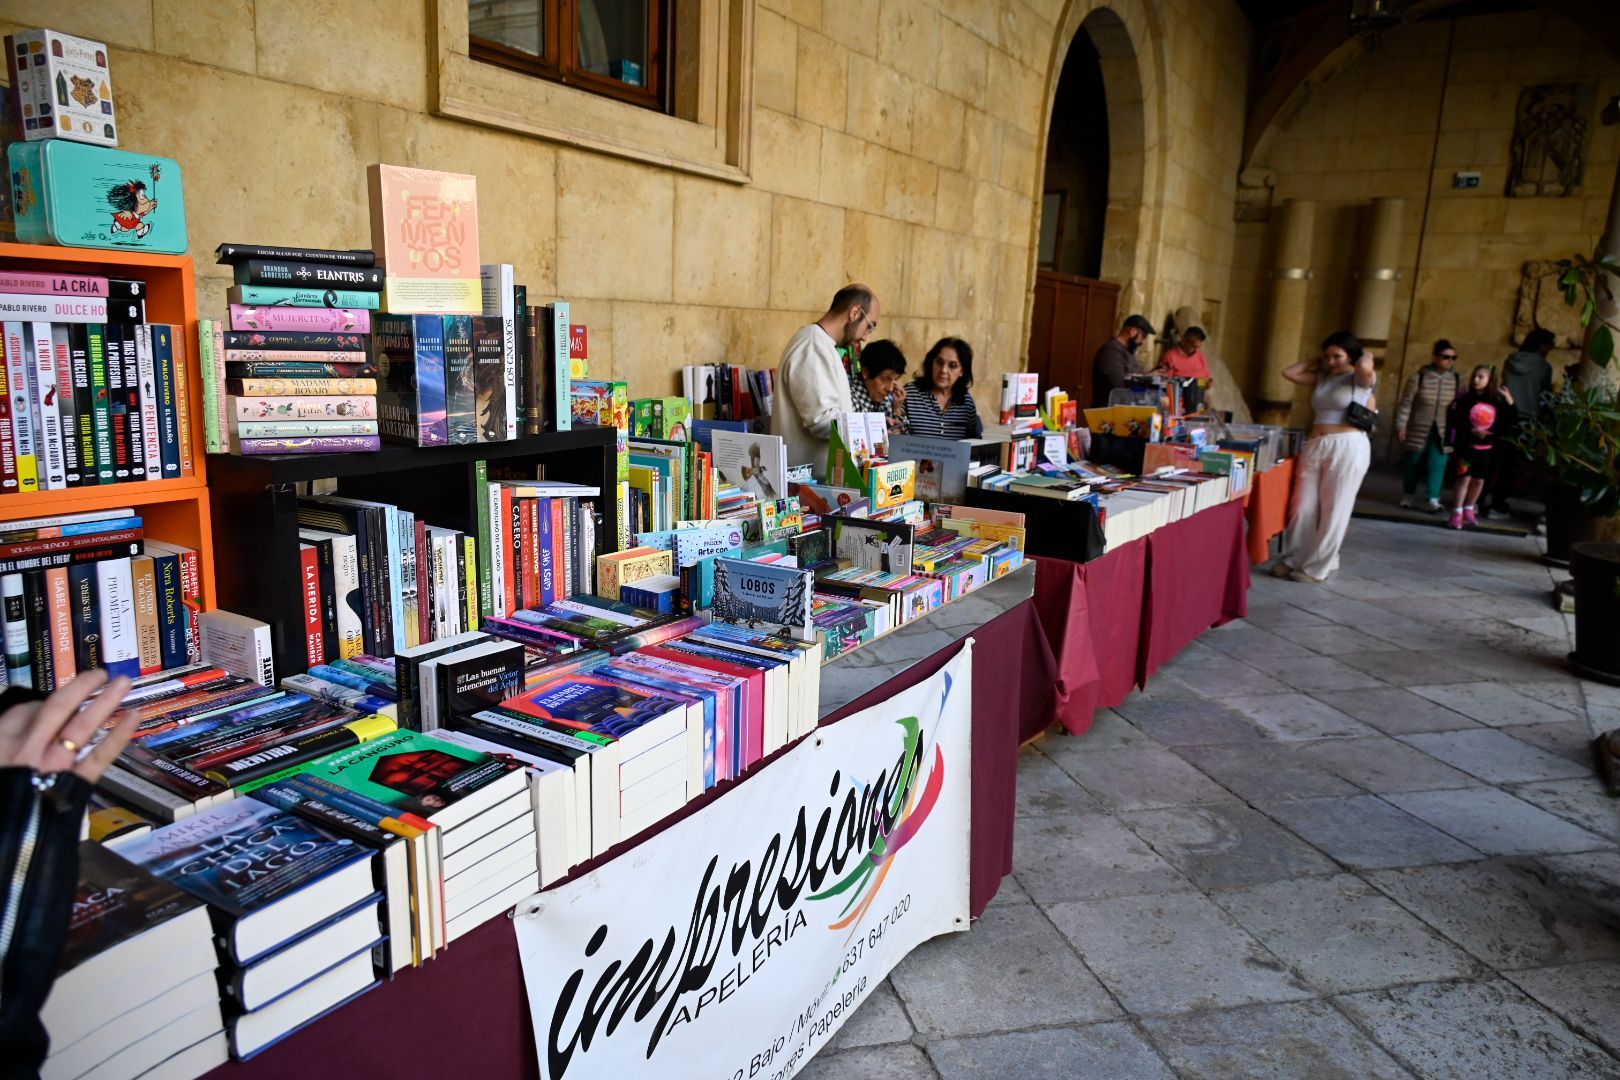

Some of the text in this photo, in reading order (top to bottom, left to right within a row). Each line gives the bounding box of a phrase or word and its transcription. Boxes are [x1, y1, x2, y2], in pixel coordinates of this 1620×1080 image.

[20, 280, 45, 288] RIVERO
[52, 279, 99, 293] LA CRÍA
[260, 271, 292, 279] SANDERSON
[316, 270, 365, 284] ELANTRIS
[22, 305, 47, 313] RIVERO
[55, 304, 88, 315] DULCE
[272, 314, 332, 323] MUJERCITAS
[9, 336, 22, 367] ASISTENTA
[38, 339, 52, 371] EL NOVIO
[90, 334, 105, 387] QUERIDA DEBBIE
[107, 342, 122, 389] LA PROFESORA
[123, 340, 138, 388] TRAS LA PUERTA
[505, 318, 515, 388] LOS GNOMOS
[55, 344, 72, 399] NUNCA MIENTAS
[73, 350, 88, 388] EL RECLUSO
[140, 357, 148, 378] RIVERO
[291, 379, 333, 387] MADAME
[162, 381, 171, 405] RIVERO
[176, 363, 189, 444] WHISKY MUERTE
[18, 416, 32, 438] FREIDA
[79, 414, 94, 467] FREIDA McFADDEN
[96, 407, 111, 465] FREIDA McFADDEN
[113, 413, 127, 465] FREIDA McFADDEN
[130, 411, 143, 463] FREIDA McFADDEN
[144, 404, 157, 459] PENITENCIA
[164, 408, 174, 444] EL REBAÑO
[0, 418, 15, 474] FREIDA McFADDEN
[45, 415, 60, 470] FREIDA McFADDEN
[62, 415, 77, 469] FREIDA McFADDEN
[886, 467, 908, 484] ROBOT!
[73, 538, 90, 546] SILVIA
[512, 505, 521, 549] CASERO
[563, 531, 571, 550] LLENA
[42, 541, 70, 550] SILENCIO
[402, 548, 408, 556] LA
[409, 546, 415, 555] LA
[698, 546, 729, 556] Arte con
[703, 539, 723, 548] FROZEN
[0, 556, 52, 573] EN EL NOMBRE DEL
[181, 561, 191, 593] GILBERT
[189, 556, 199, 596] ELIZABETH
[341, 554, 350, 577] negro
[348, 544, 357, 585] El albatros
[542, 548, 552, 591] GIPSY CHEF
[79, 578, 90, 606] SIERRA
[137, 577, 146, 613] DORADO
[144, 573, 154, 615] EL VIÑEDO
[162, 562, 176, 625] Nora Roberts
[306, 565, 318, 624] LA HERIDA
[740, 577, 776, 595] LOBOS
[54, 577, 70, 653] ISABEL ALLENDE
[107, 576, 121, 640] PROMETIDA
[121, 599, 130, 614] LA
[482, 599, 487, 610] EL
[141, 624, 151, 669] GUERRERO
[148, 624, 158, 665] MERCEDES
[169, 628, 177, 655] Visiones
[185, 627, 194, 641] DEL
[308, 633, 316, 664] WAHRER
[315, 632, 323, 662] CAITLIN
[262, 656, 273, 688] UERTE
[456, 676, 498, 694] intenciones
[465, 665, 506, 682] Las buenas
[487, 684, 499, 693] del
[544, 685, 596, 709] BENAVENT
[480, 713, 510, 726] JAVIER
[509, 720, 550, 736] CASTILLO
[226, 744, 299, 772] MENTIRA
[327, 735, 415, 776] LA CANGURO
[267, 787, 301, 803] SANTIAGO
[145, 809, 255, 858] SANTIAGO
[156, 813, 226, 844] MIKEL
[201, 832, 245, 851] LA
[179, 824, 296, 876] CHICA
[222, 840, 291, 874] DEL
[224, 841, 317, 889] LAGO
[547, 728, 924, 1080] impresiones
[749, 1035, 786, 1079] Bajo
[841, 936, 865, 974] 637
[867, 914, 890, 949] 647
[890, 893, 911, 925] 020
[807, 975, 867, 1047] Papelería
